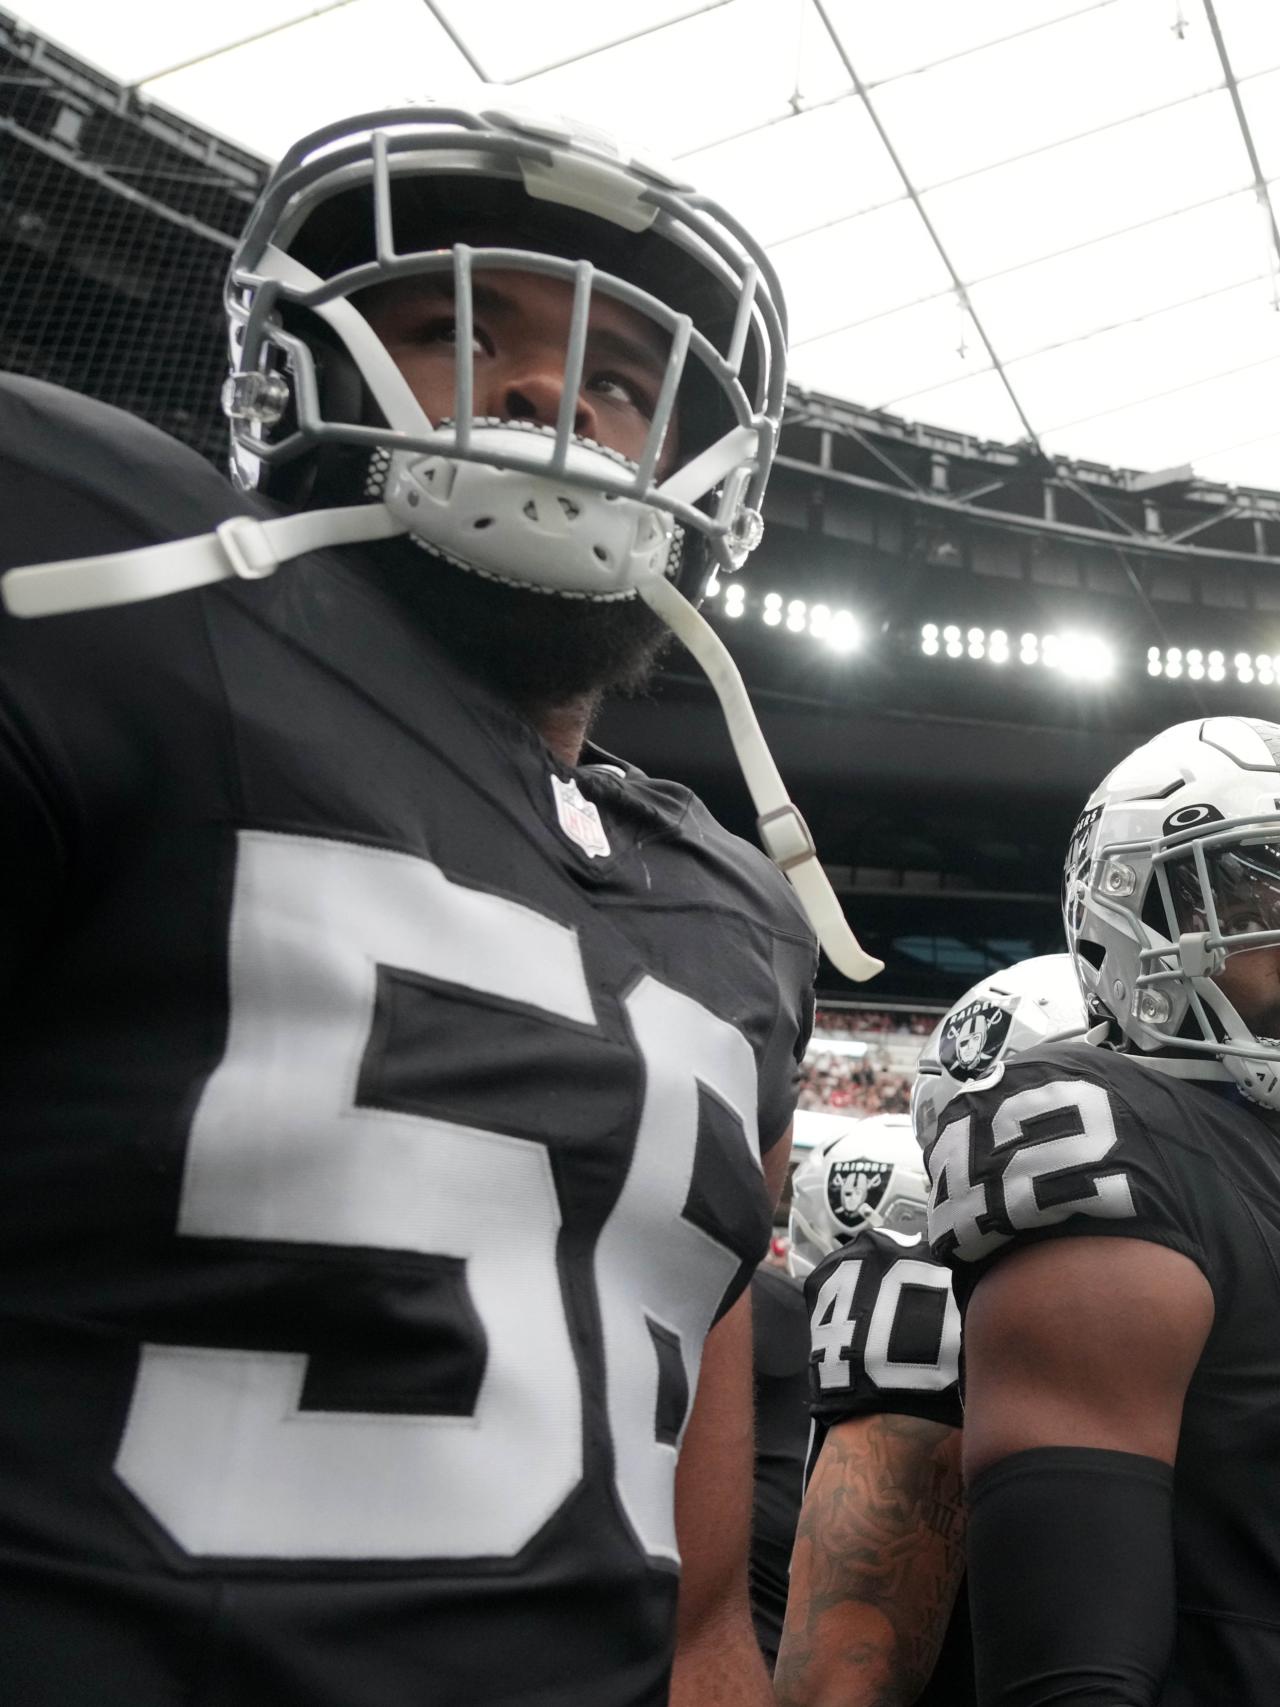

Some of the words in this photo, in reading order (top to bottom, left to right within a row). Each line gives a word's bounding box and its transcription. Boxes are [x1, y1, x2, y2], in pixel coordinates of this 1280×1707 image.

[114, 831, 763, 1567] 56
[834, 1161, 889, 1174] RAIDERS
[927, 1080, 1137, 1262] 42
[811, 1259, 962, 1391] 40
